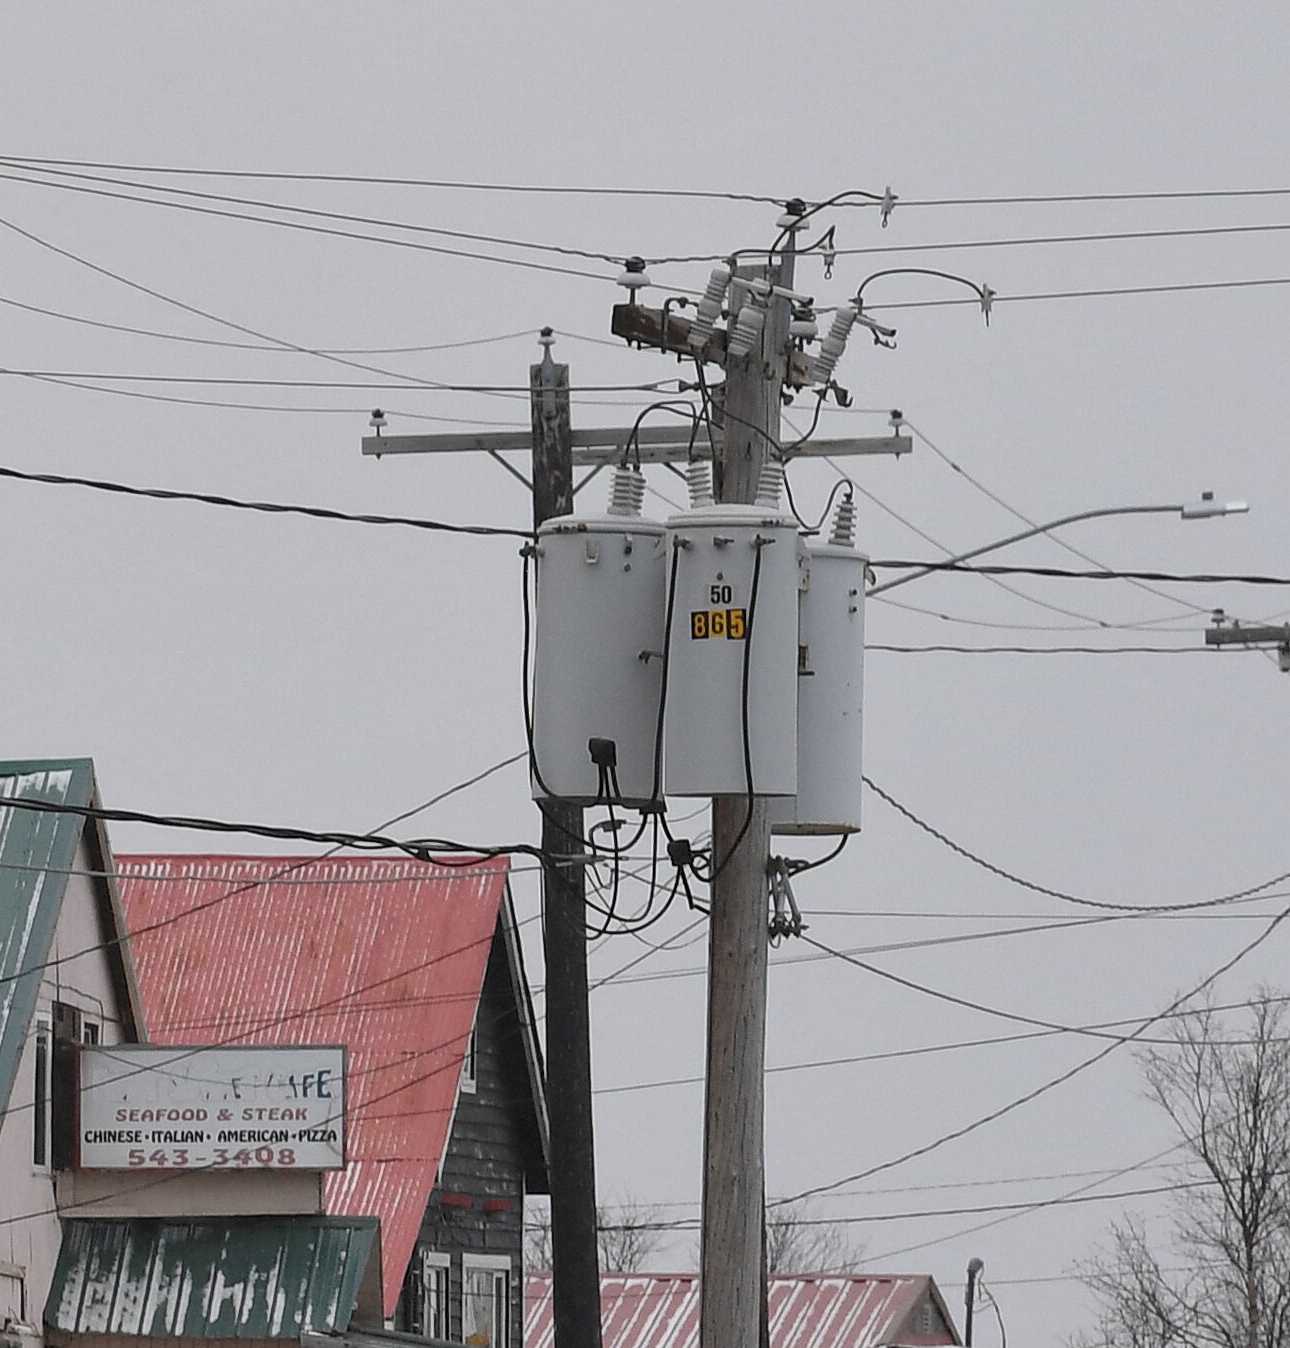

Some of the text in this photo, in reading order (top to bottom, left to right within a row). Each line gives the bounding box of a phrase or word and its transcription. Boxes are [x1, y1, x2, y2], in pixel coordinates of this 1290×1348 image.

[710, 584, 732, 604] 50
[693, 610, 745, 638] 865
[115, 1107, 308, 1122] SEAFOOD & STEAK
[84, 1129, 142, 1143] CHINESE
[217, 1129, 289, 1143] AMERICAN
[298, 1129, 337, 1143] PIZZA
